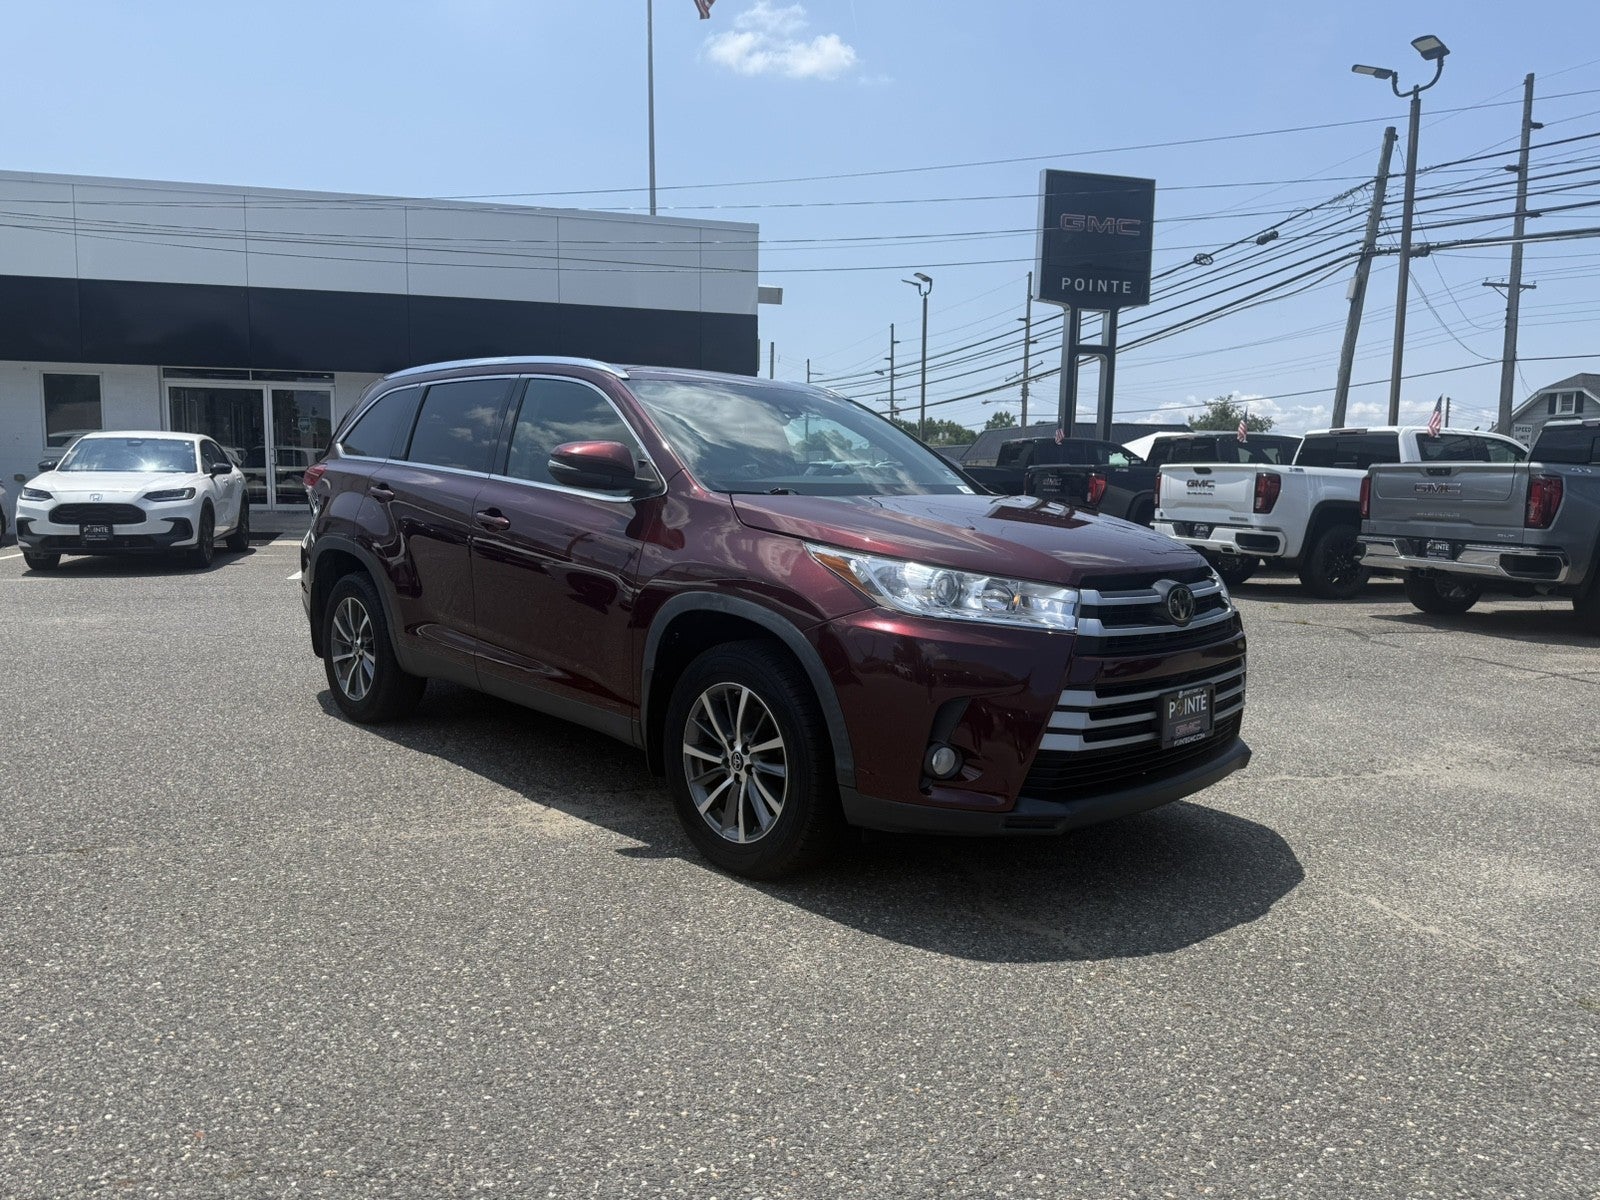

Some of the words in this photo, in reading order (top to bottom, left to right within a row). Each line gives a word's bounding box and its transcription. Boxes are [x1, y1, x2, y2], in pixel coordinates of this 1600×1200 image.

[1060, 213, 1142, 236] GMC
[1061, 277, 1132, 294] POINTE
[1186, 479, 1216, 488] GMC
[1414, 482, 1462, 495] GMC
[1168, 693, 1208, 719] POINTE
